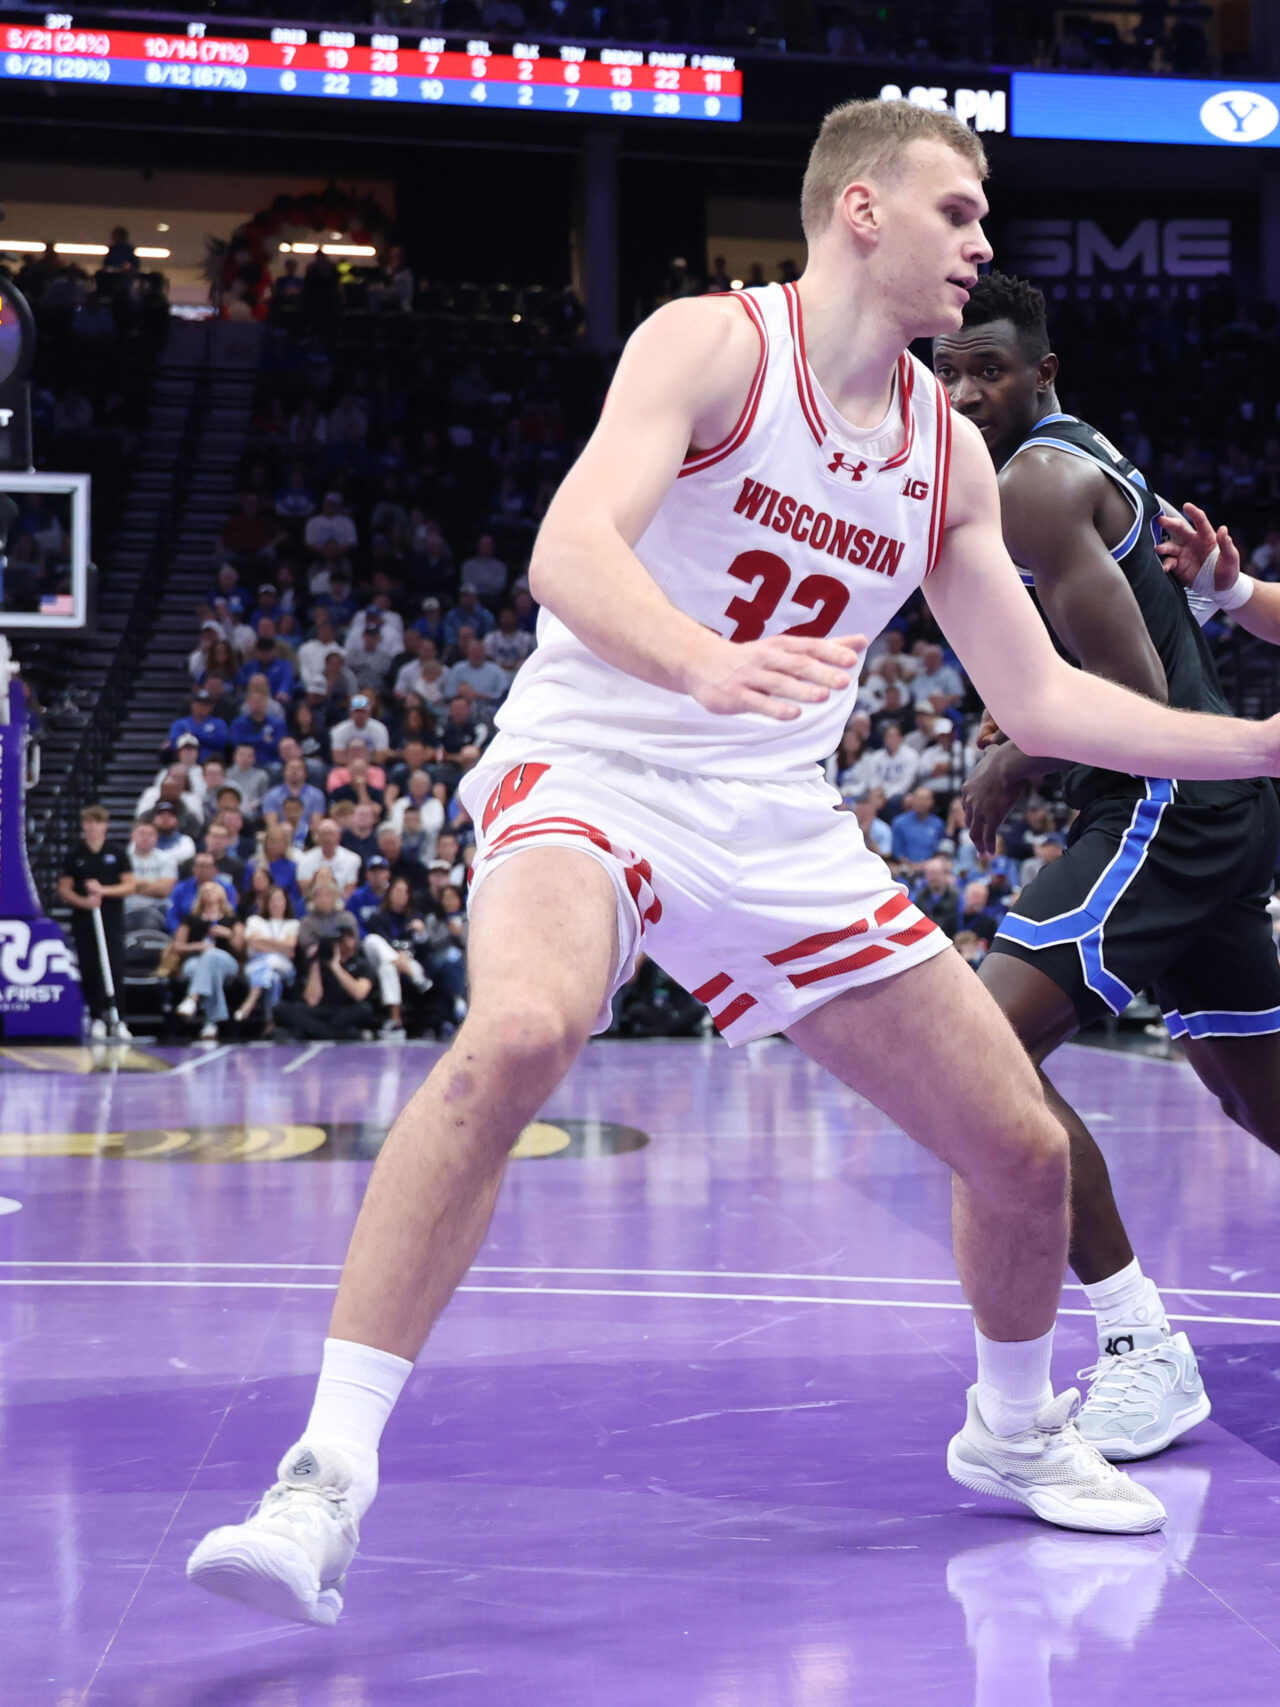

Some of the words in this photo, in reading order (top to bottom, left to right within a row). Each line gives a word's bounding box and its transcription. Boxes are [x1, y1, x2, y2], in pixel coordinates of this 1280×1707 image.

[7, 29, 52, 50] 5/21
[144, 38, 198, 60] 10/14
[282, 45, 296, 65] 7
[325, 49, 348, 69] 19
[425, 54, 440, 74] 7
[471, 58, 487, 78] 5
[518, 60, 534, 81] 2
[610, 66, 632, 87] 13
[654, 69, 680, 90] 22
[704, 73, 721, 92] 11
[467, 40, 492, 57] STL
[5, 54, 52, 76] 6/21
[279, 69, 297, 91] 6
[323, 72, 350, 94] 22
[420, 78, 444, 100] 10
[470, 82, 487, 103] 4
[518, 84, 533, 106] 2
[564, 88, 580, 108] 7
[1218, 99, 1262, 133] Y
[1007, 218, 1232, 278] SME
[733, 477, 905, 577] WISCONSIN
[5, 984, 65, 1003] FIRST
